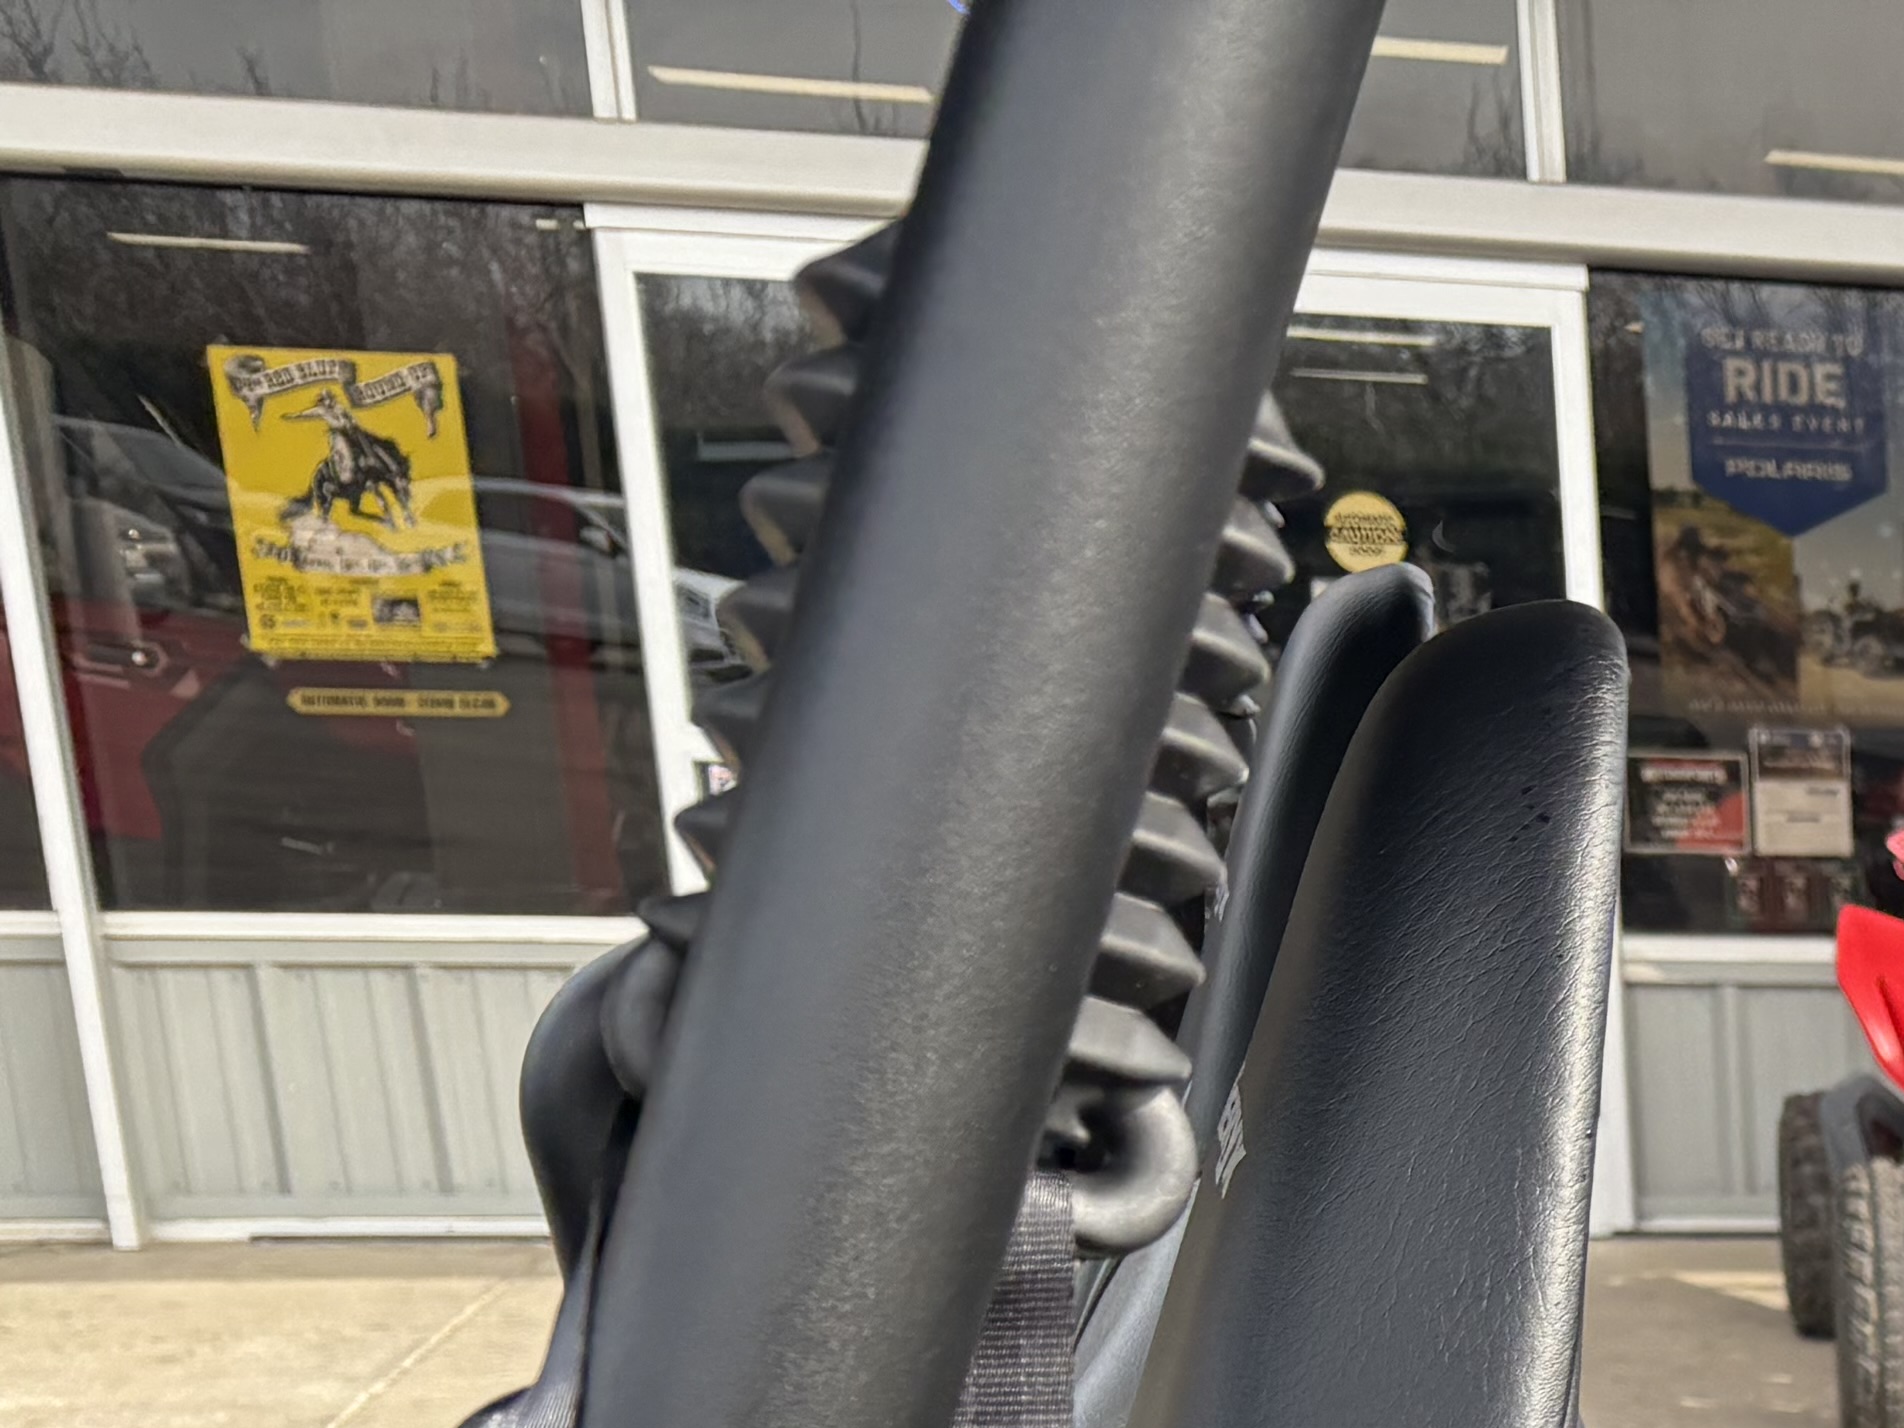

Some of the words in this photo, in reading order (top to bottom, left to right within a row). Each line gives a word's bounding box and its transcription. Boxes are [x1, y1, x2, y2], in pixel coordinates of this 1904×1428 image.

[1723, 358, 1847, 410] RIDE
[1706, 411, 1783, 431] SALES
[1791, 415, 1865, 434] EVENT
[1725, 458, 1853, 482] POLARIS
